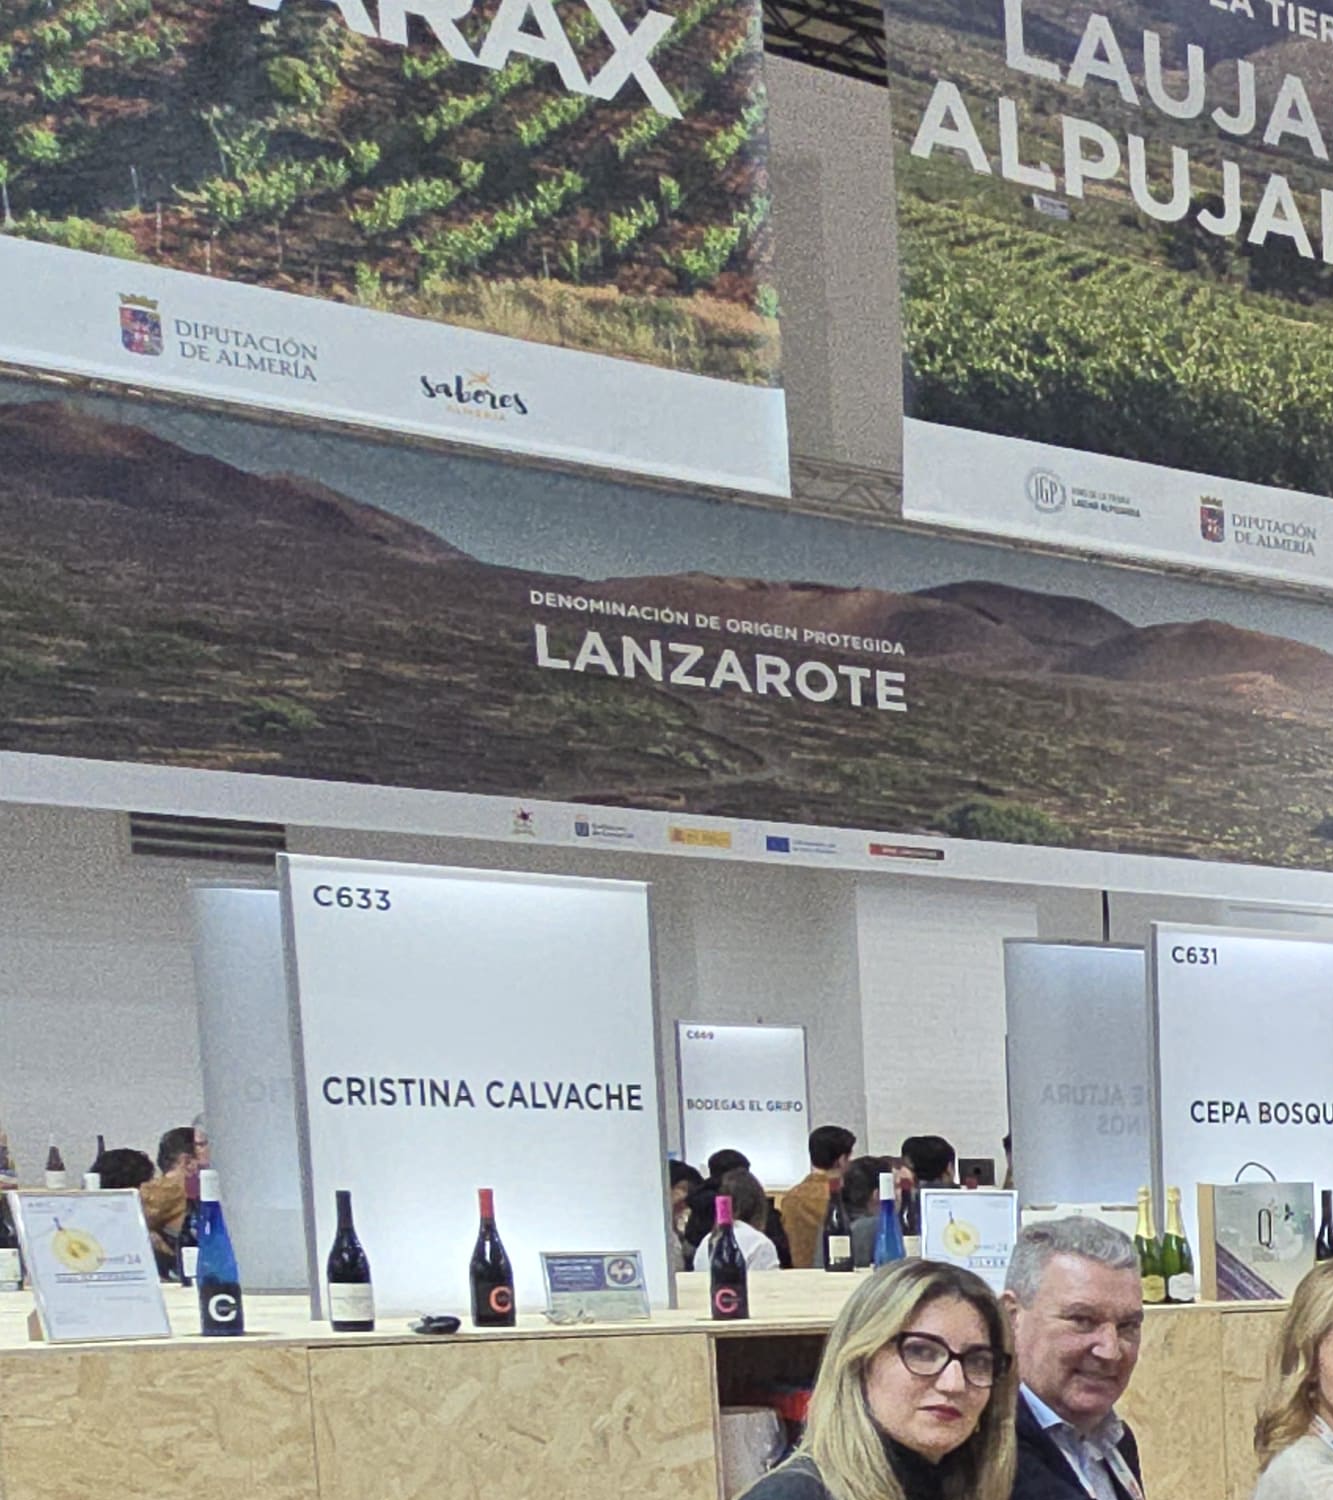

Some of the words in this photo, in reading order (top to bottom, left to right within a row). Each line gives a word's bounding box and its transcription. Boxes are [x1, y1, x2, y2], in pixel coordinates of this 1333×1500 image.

[174, 318, 318, 361] DIPUTACIÓN
[180, 340, 209, 361] DE
[216, 348, 317, 382] ALMERÍA
[1231, 512, 1317, 541] DIPUTACIÓN
[1234, 529, 1253, 546] DE
[1254, 533, 1316, 557] ALMERÍA
[529, 589, 689, 626] DENOMINACIÓN
[696, 613, 721, 631] DE
[726, 618, 798, 641] ORIGEN
[803, 629, 906, 656] PROTEGIDA
[534, 623, 908, 712] LANZAROTE
[312, 884, 392, 911] C633
[1171, 945, 1219, 966] C631
[322, 1076, 475, 1109] CRISTINA
[485, 1079, 644, 1112] CALVACHE
[686, 1099, 745, 1111] BODEGAS
[749, 1100, 763, 1111] EL
[1190, 1100, 1251, 1125] CEPA
[208, 1293, 237, 1321] C
[489, 1286, 513, 1313] C
[715, 1288, 738, 1314] C
